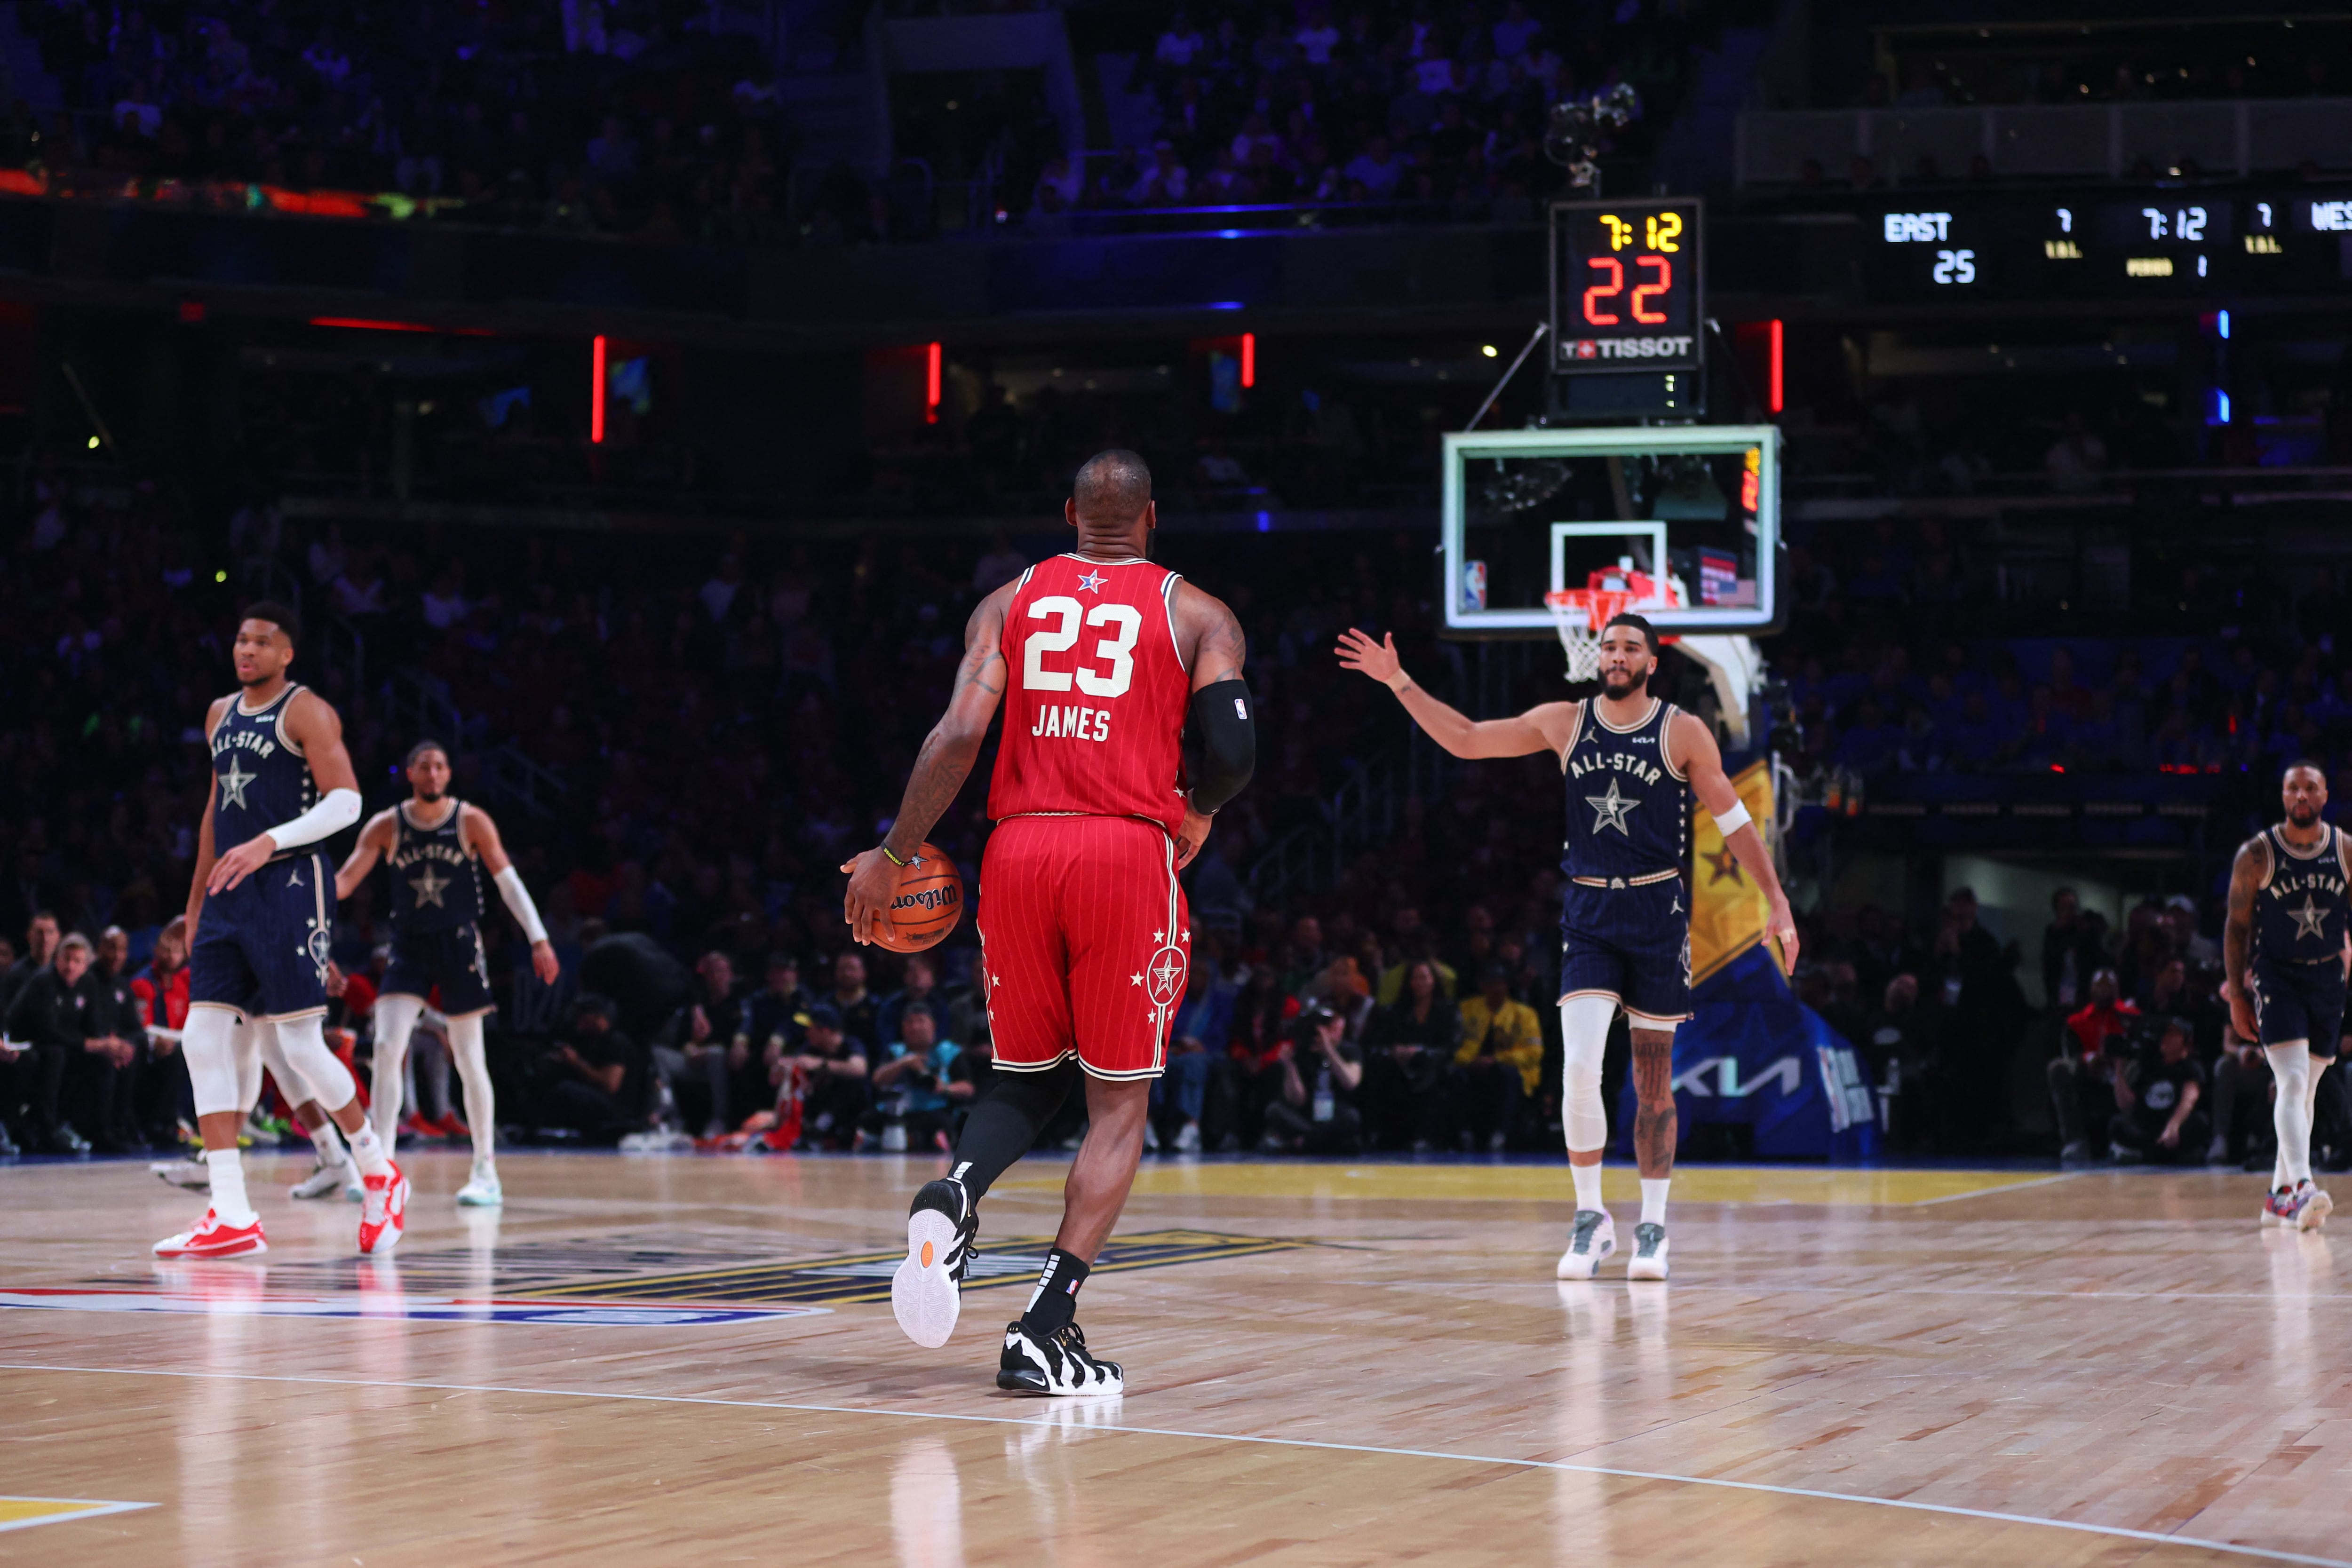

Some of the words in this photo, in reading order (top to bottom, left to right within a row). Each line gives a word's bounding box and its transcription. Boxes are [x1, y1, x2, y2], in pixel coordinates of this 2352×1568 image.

[1884, 212, 1952, 242] EAST
[2056, 208, 2072, 233] 7
[2141, 206, 2207, 241] 7:12
[2257, 203, 2272, 227] 7
[1599, 212, 1682, 252] 7:12
[1933, 249, 1976, 284] 25
[2198, 254, 2207, 277] 1
[1583, 256, 1671, 325] 22
[1596, 336, 1693, 358] TISSOT
[1023, 596, 1143, 698] 23
[1032, 705, 1111, 742] JAMES
[1571, 752, 1661, 786] ALL-STAR
[883, 847, 902, 865] PROMISE
[890, 884, 958, 911] Wilson
[2270, 873, 2345, 900] ALL-STAR
